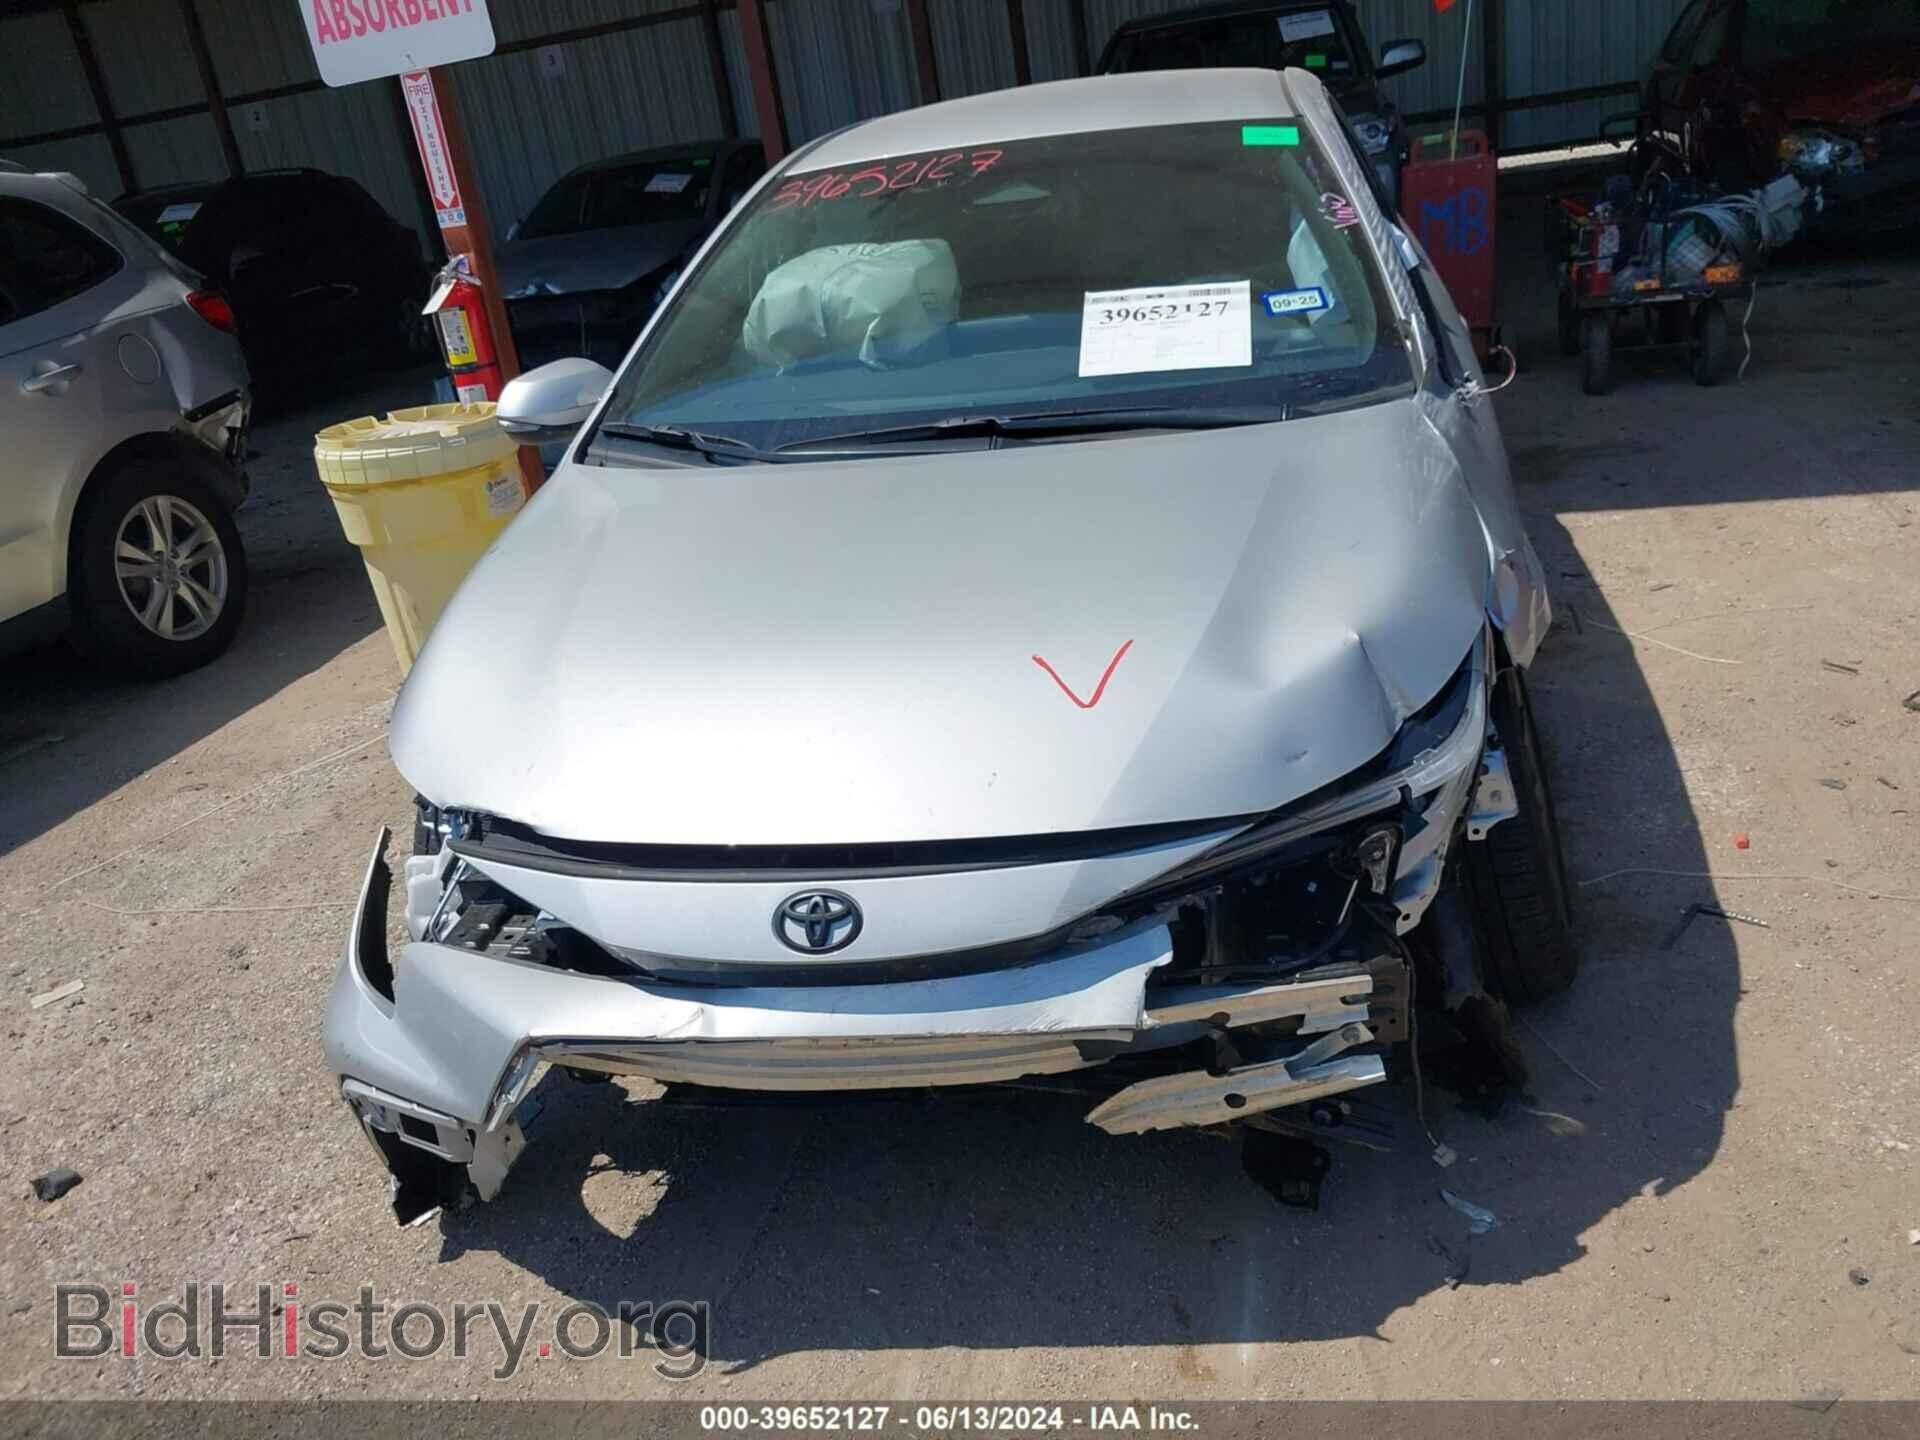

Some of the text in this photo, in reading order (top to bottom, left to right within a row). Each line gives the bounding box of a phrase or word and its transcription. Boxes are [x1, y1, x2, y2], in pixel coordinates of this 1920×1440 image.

[313, 0, 473, 45] ABSORB
[407, 83, 431, 96] FIRE
[418, 97, 450, 199] EXTINGUISHER
[774, 150, 1003, 206] 39652127
[1423, 188, 1488, 255] MB
[1099, 301, 1229, 325] 39652127
